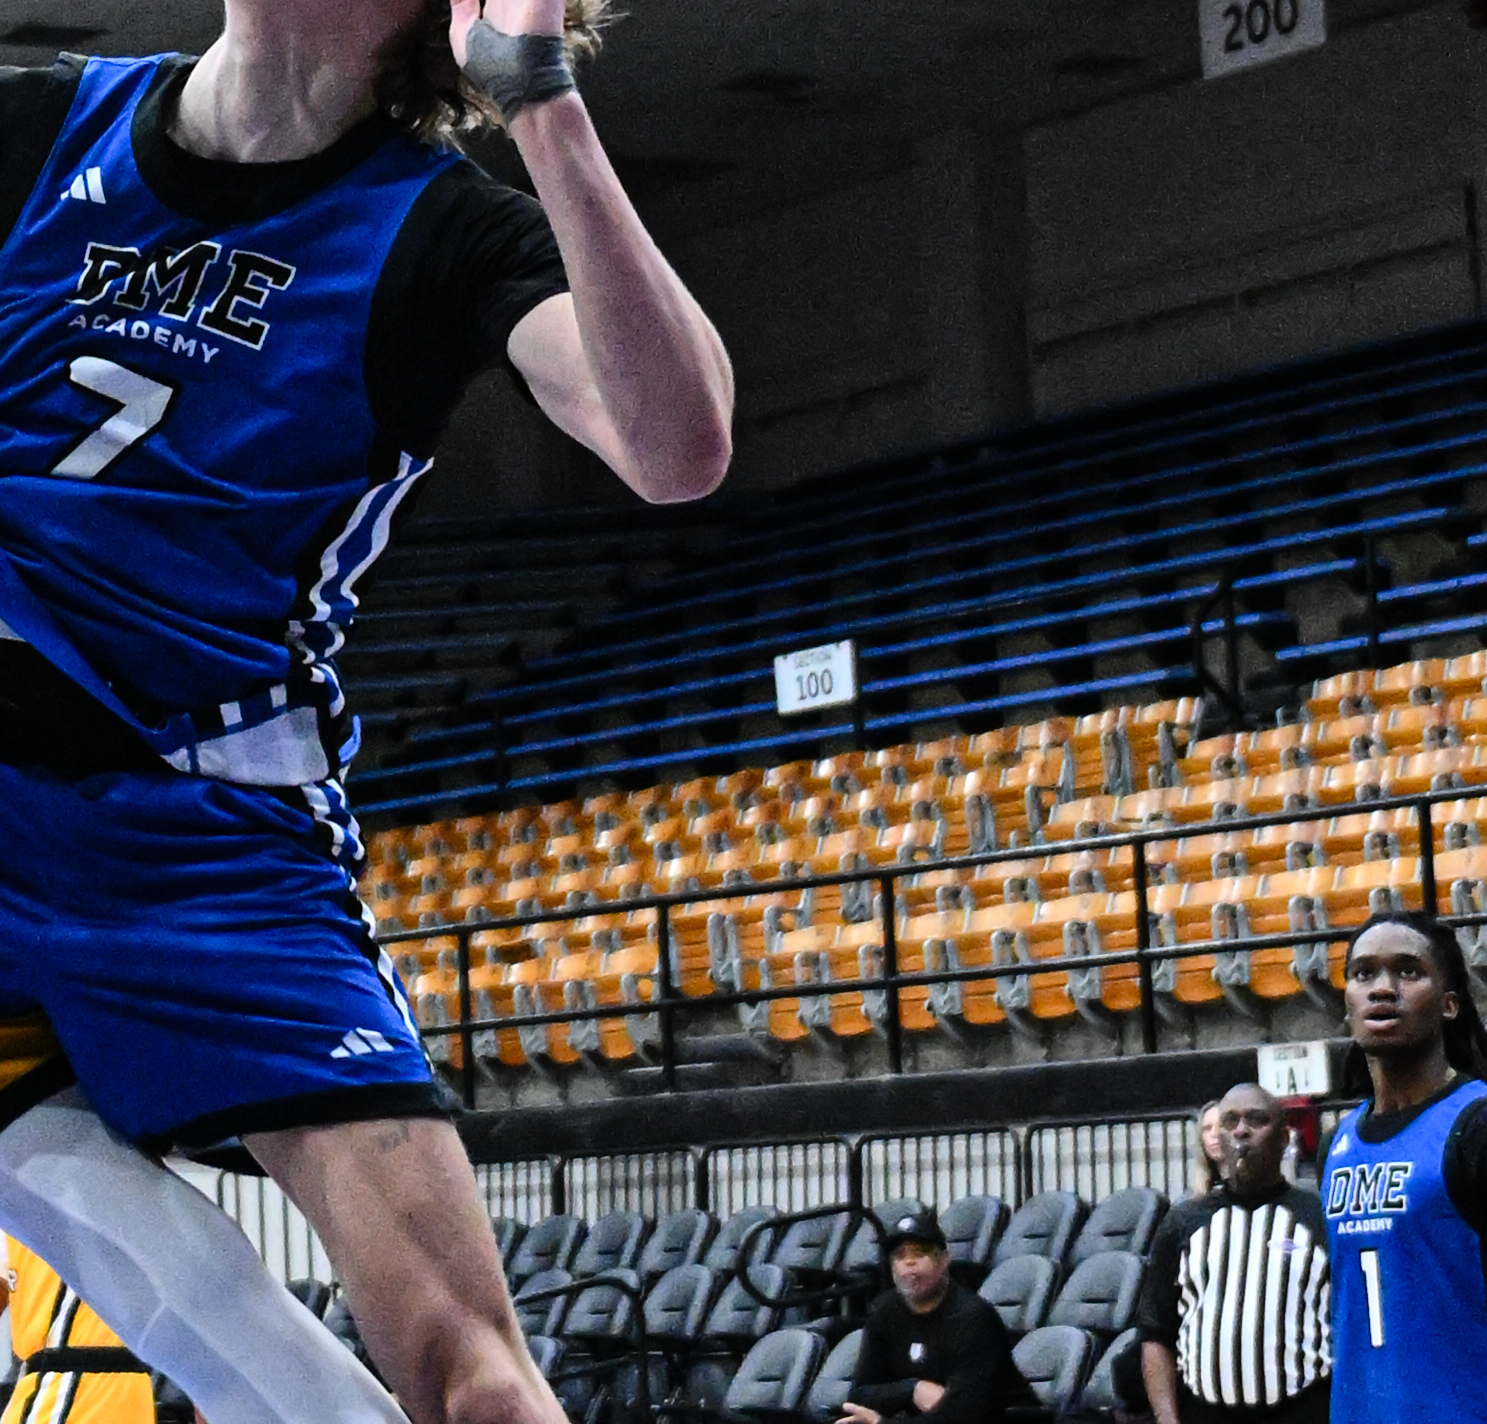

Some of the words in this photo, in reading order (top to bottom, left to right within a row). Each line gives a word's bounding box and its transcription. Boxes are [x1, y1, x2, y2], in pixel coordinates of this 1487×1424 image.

[65, 241, 296, 351] DME
[68, 314, 220, 364] ACADEMY
[50, 355, 174, 479] 7
[797, 669, 833, 701] 100
[1326, 1161, 1413, 1219] DME
[1337, 1217, 1393, 1235] ACADEMY
[1360, 1248, 1385, 1348] 1
